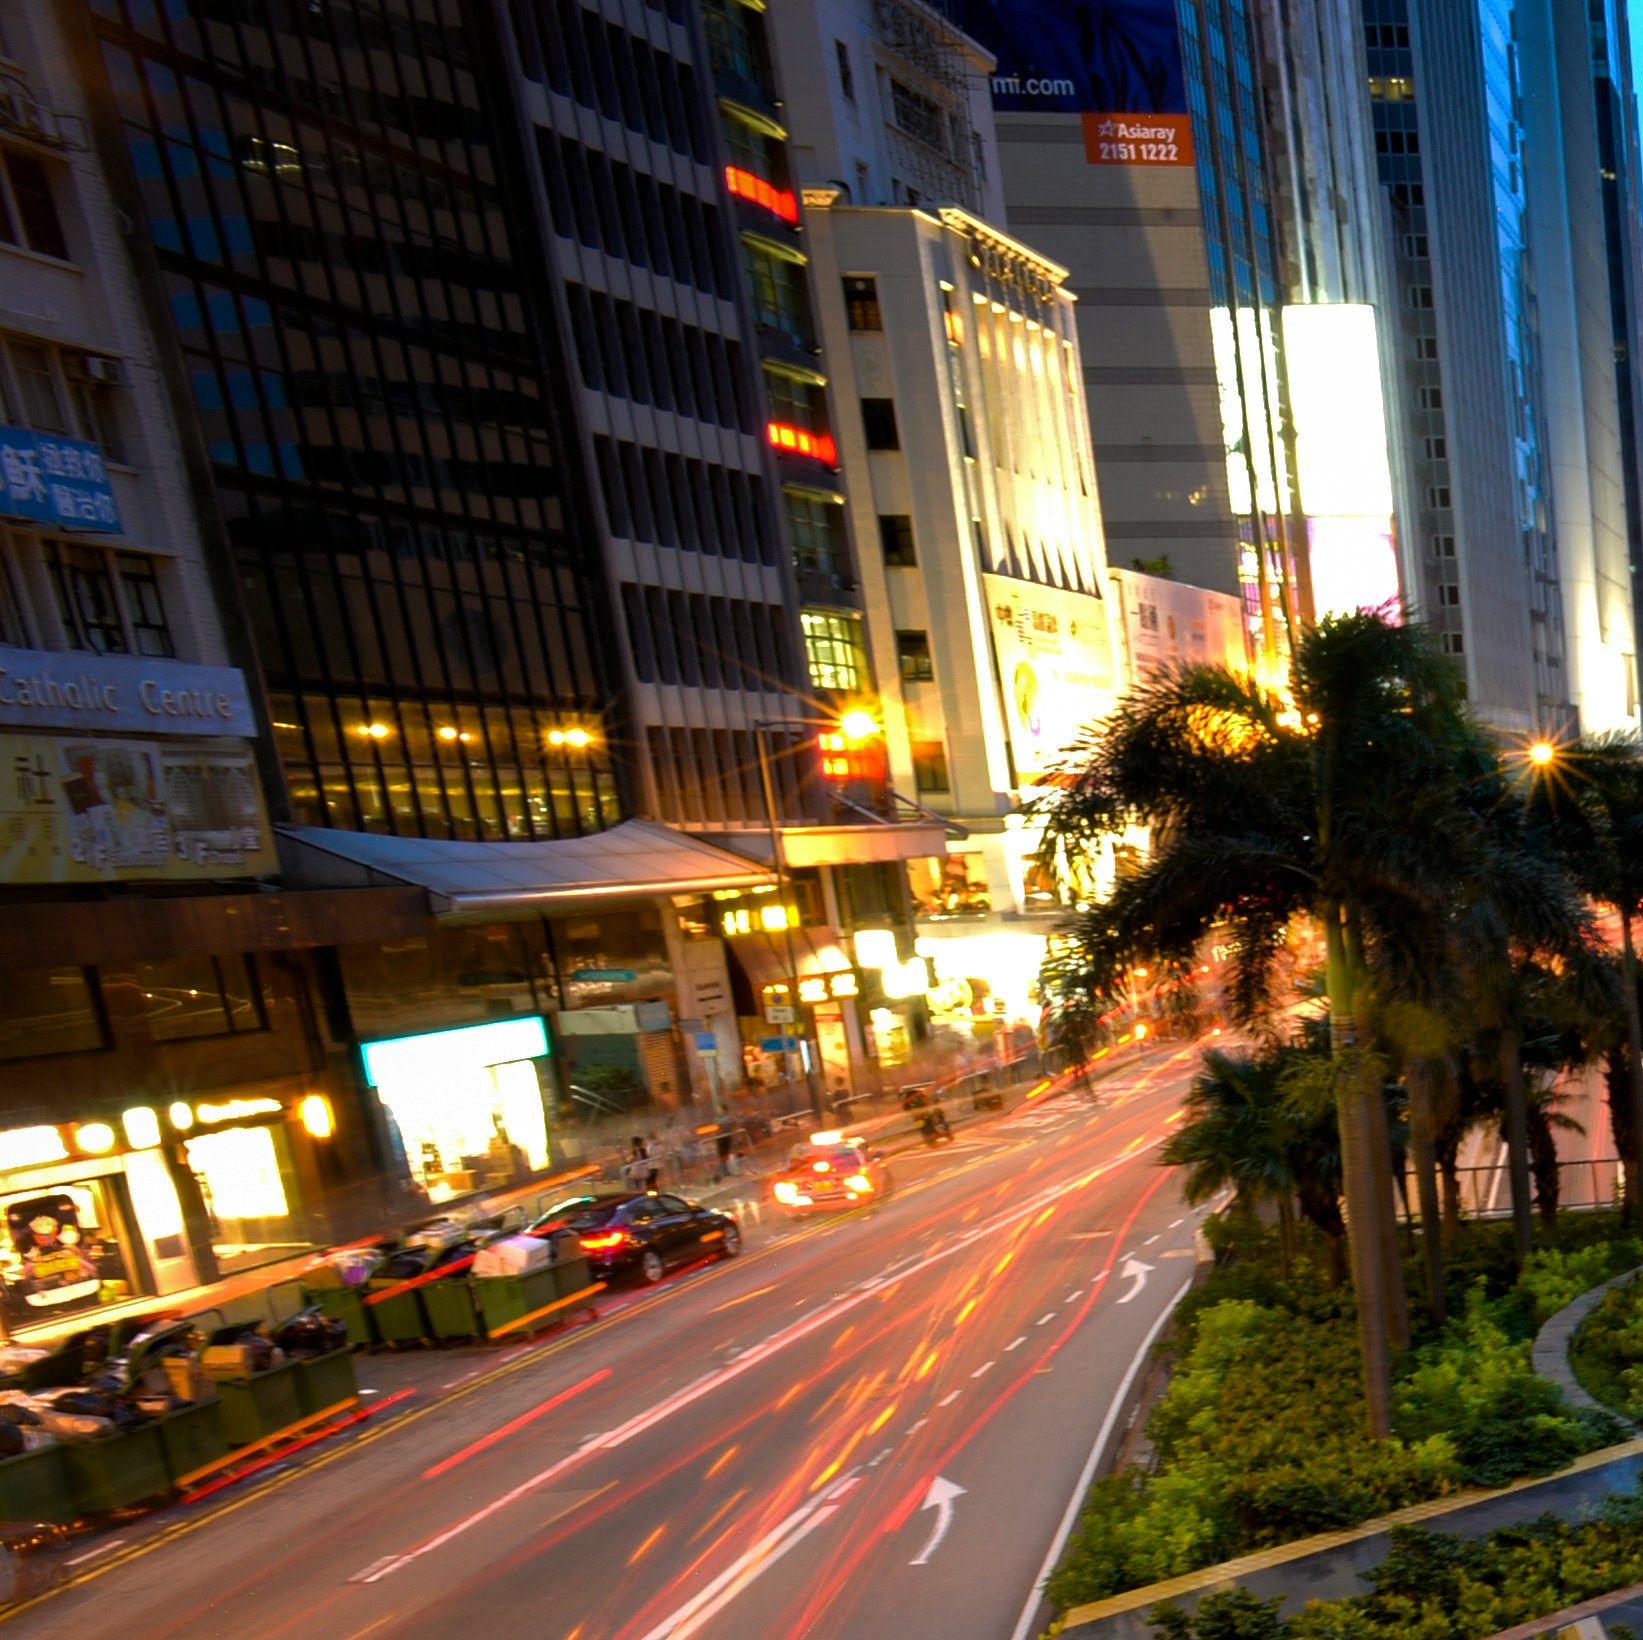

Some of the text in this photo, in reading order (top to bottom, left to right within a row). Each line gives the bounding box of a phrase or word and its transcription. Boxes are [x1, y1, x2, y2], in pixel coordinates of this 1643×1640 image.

[992, 73, 1075, 96] mi.com
[1118, 123, 1175, 142] Asiaray
[1101, 144, 1178, 160] 2151 1222
[0, 668, 232, 719] Catholic Centre
